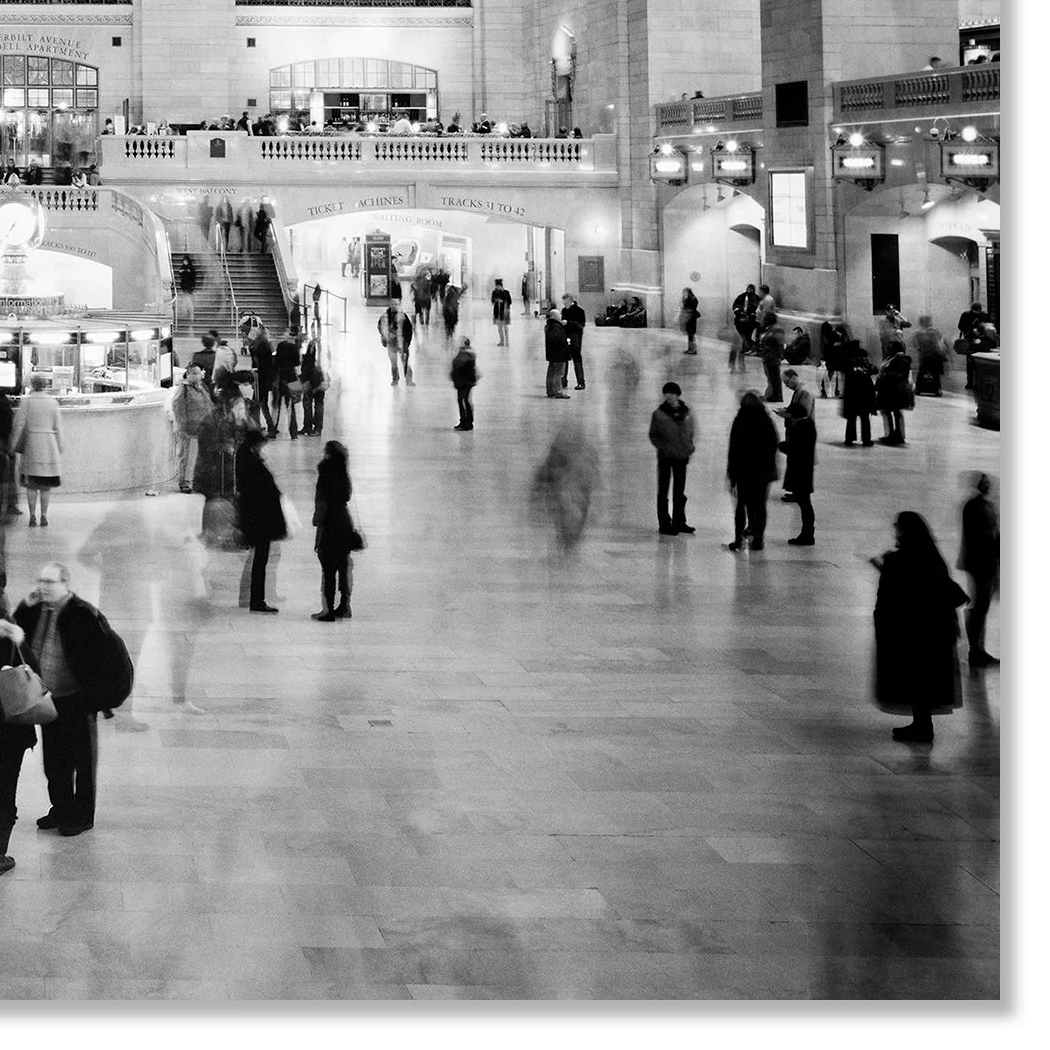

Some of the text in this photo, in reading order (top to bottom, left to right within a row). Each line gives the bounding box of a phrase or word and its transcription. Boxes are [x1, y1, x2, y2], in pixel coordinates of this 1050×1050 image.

[39, 35, 82, 48] AVENUE
[27, 44, 90, 60] APARTMENT
[308, 196, 404, 216] TICKET ACHINES
[441, 197, 526, 217] TRACKS 31 TO 42
[372, 213, 443, 228] WAITING ROOM
